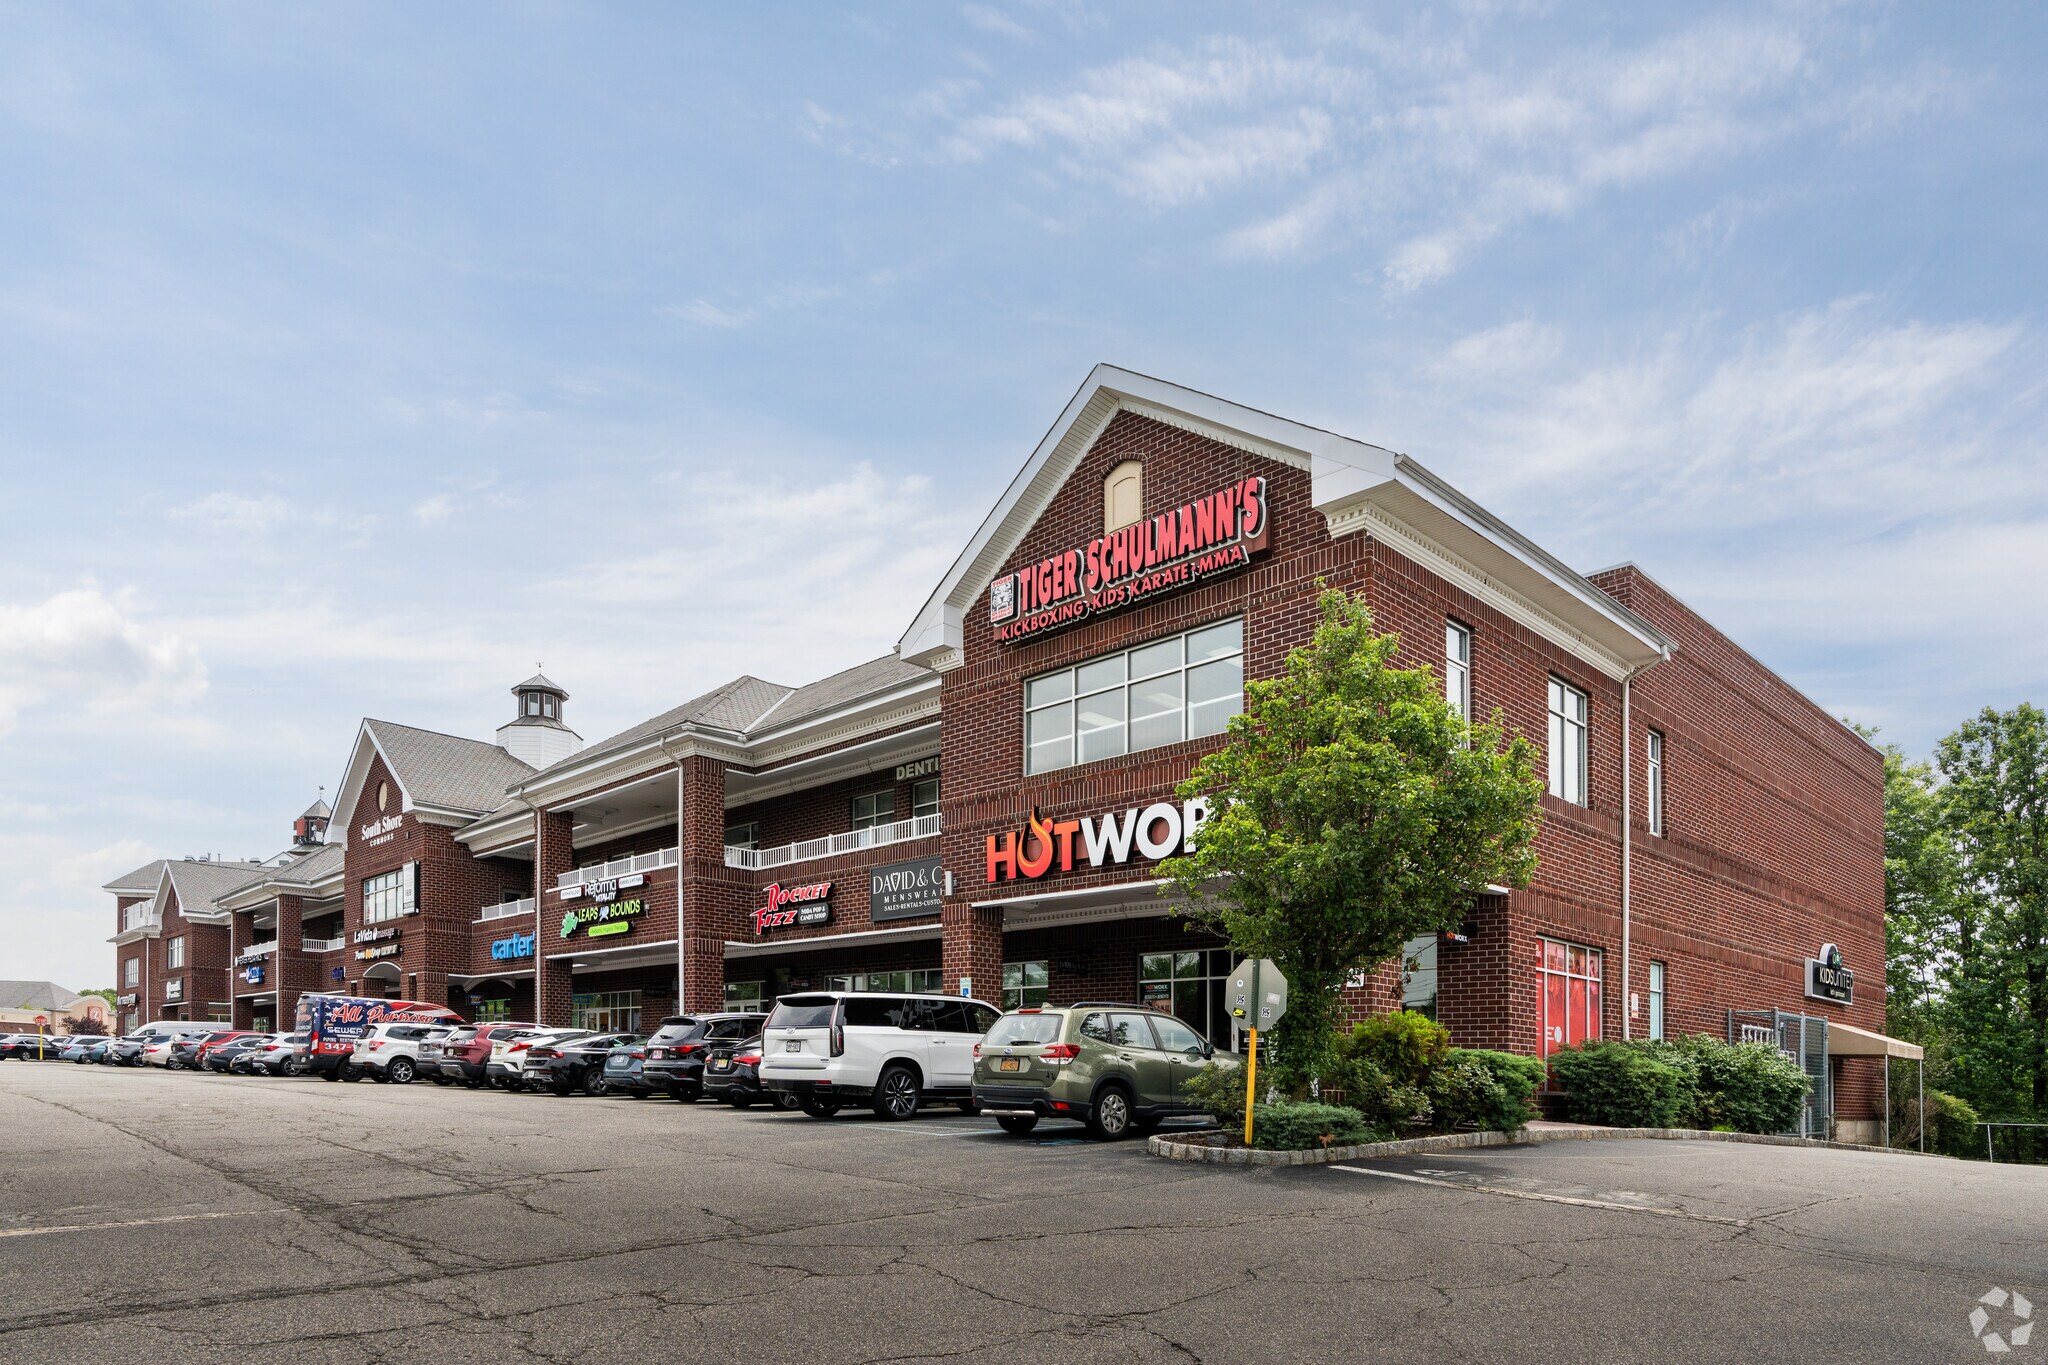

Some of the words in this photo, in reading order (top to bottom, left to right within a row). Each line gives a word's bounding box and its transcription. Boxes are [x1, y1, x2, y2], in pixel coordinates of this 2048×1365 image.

[1020, 549, 1080, 612] TIGER
[1087, 477, 1263, 589] SCHULMANN'S
[992, 575, 1012, 587] TIGER
[1001, 600, 1084, 641] KICKBOXING
[1092, 585, 1126, 612] KIDS
[1130, 565, 1189, 597] KARATE
[1199, 545, 1243, 574] MMA
[896, 756, 941, 780] DENTI
[362, 820, 381, 840] South
[381, 815, 403, 833] Shore
[986, 796, 1246, 883] HOTWOR
[873, 870, 916, 894] DAVID
[916, 868, 929, 887] &
[763, 883, 831, 912] ROCKET
[884, 899, 942, 911] SALES-RENTALS-CUSTO
[578, 907, 599, 922] LEAPS
[610, 899, 641, 917] BOUNDS
[750, 907, 797, 935] FIZZ
[354, 928, 373, 943] LaVida
[331, 1004, 363, 1024] All
